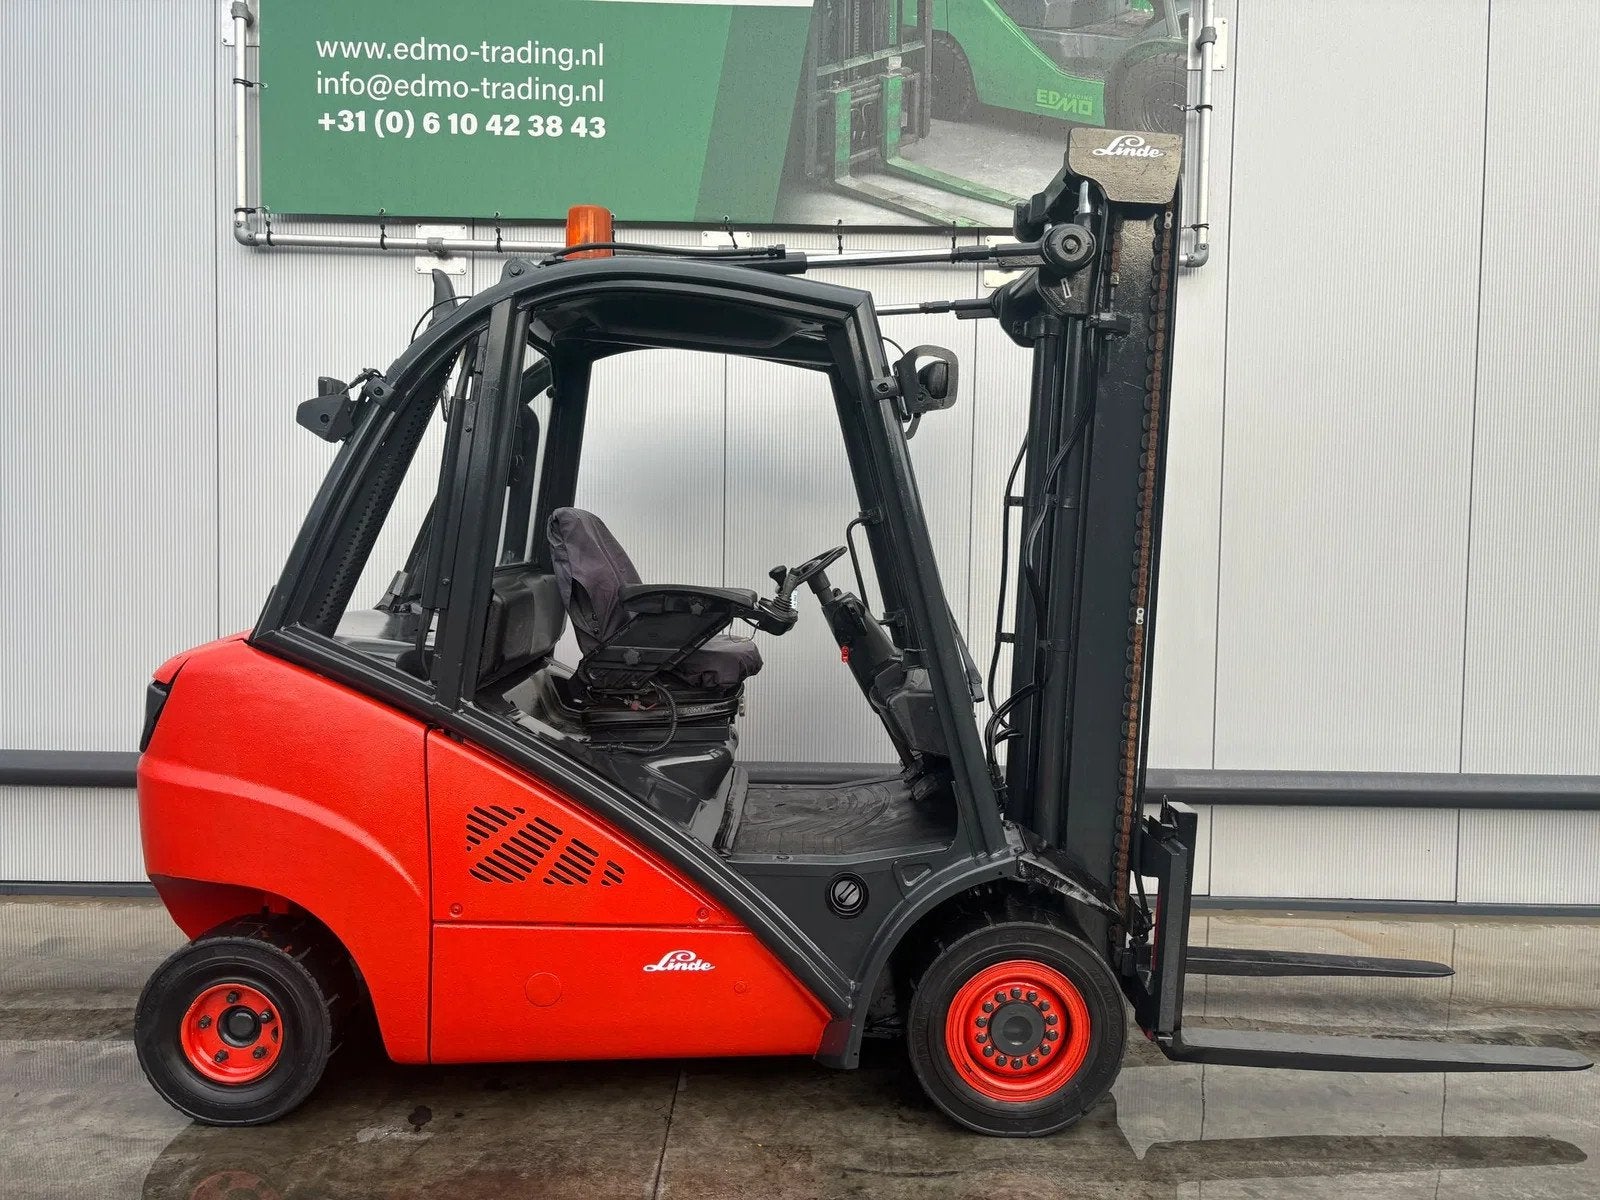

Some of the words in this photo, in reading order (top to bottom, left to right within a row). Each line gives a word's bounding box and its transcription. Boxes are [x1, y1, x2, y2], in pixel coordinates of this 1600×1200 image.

[315, 37, 604, 72] www.edmo-trading.nl
[316, 71, 605, 107] info@edmo-trading.nl
[1035, 89, 1093, 116] EDMO
[317, 109, 366, 132] +31
[374, 108, 415, 139] (0)
[422, 111, 441, 135] 6
[447, 112, 478, 136] 10
[485, 113, 521, 137] 42
[527, 114, 564, 138] 38
[570, 116, 606, 139] 43
[1092, 134, 1165, 158] Linde
[643, 949, 716, 972] Linde
